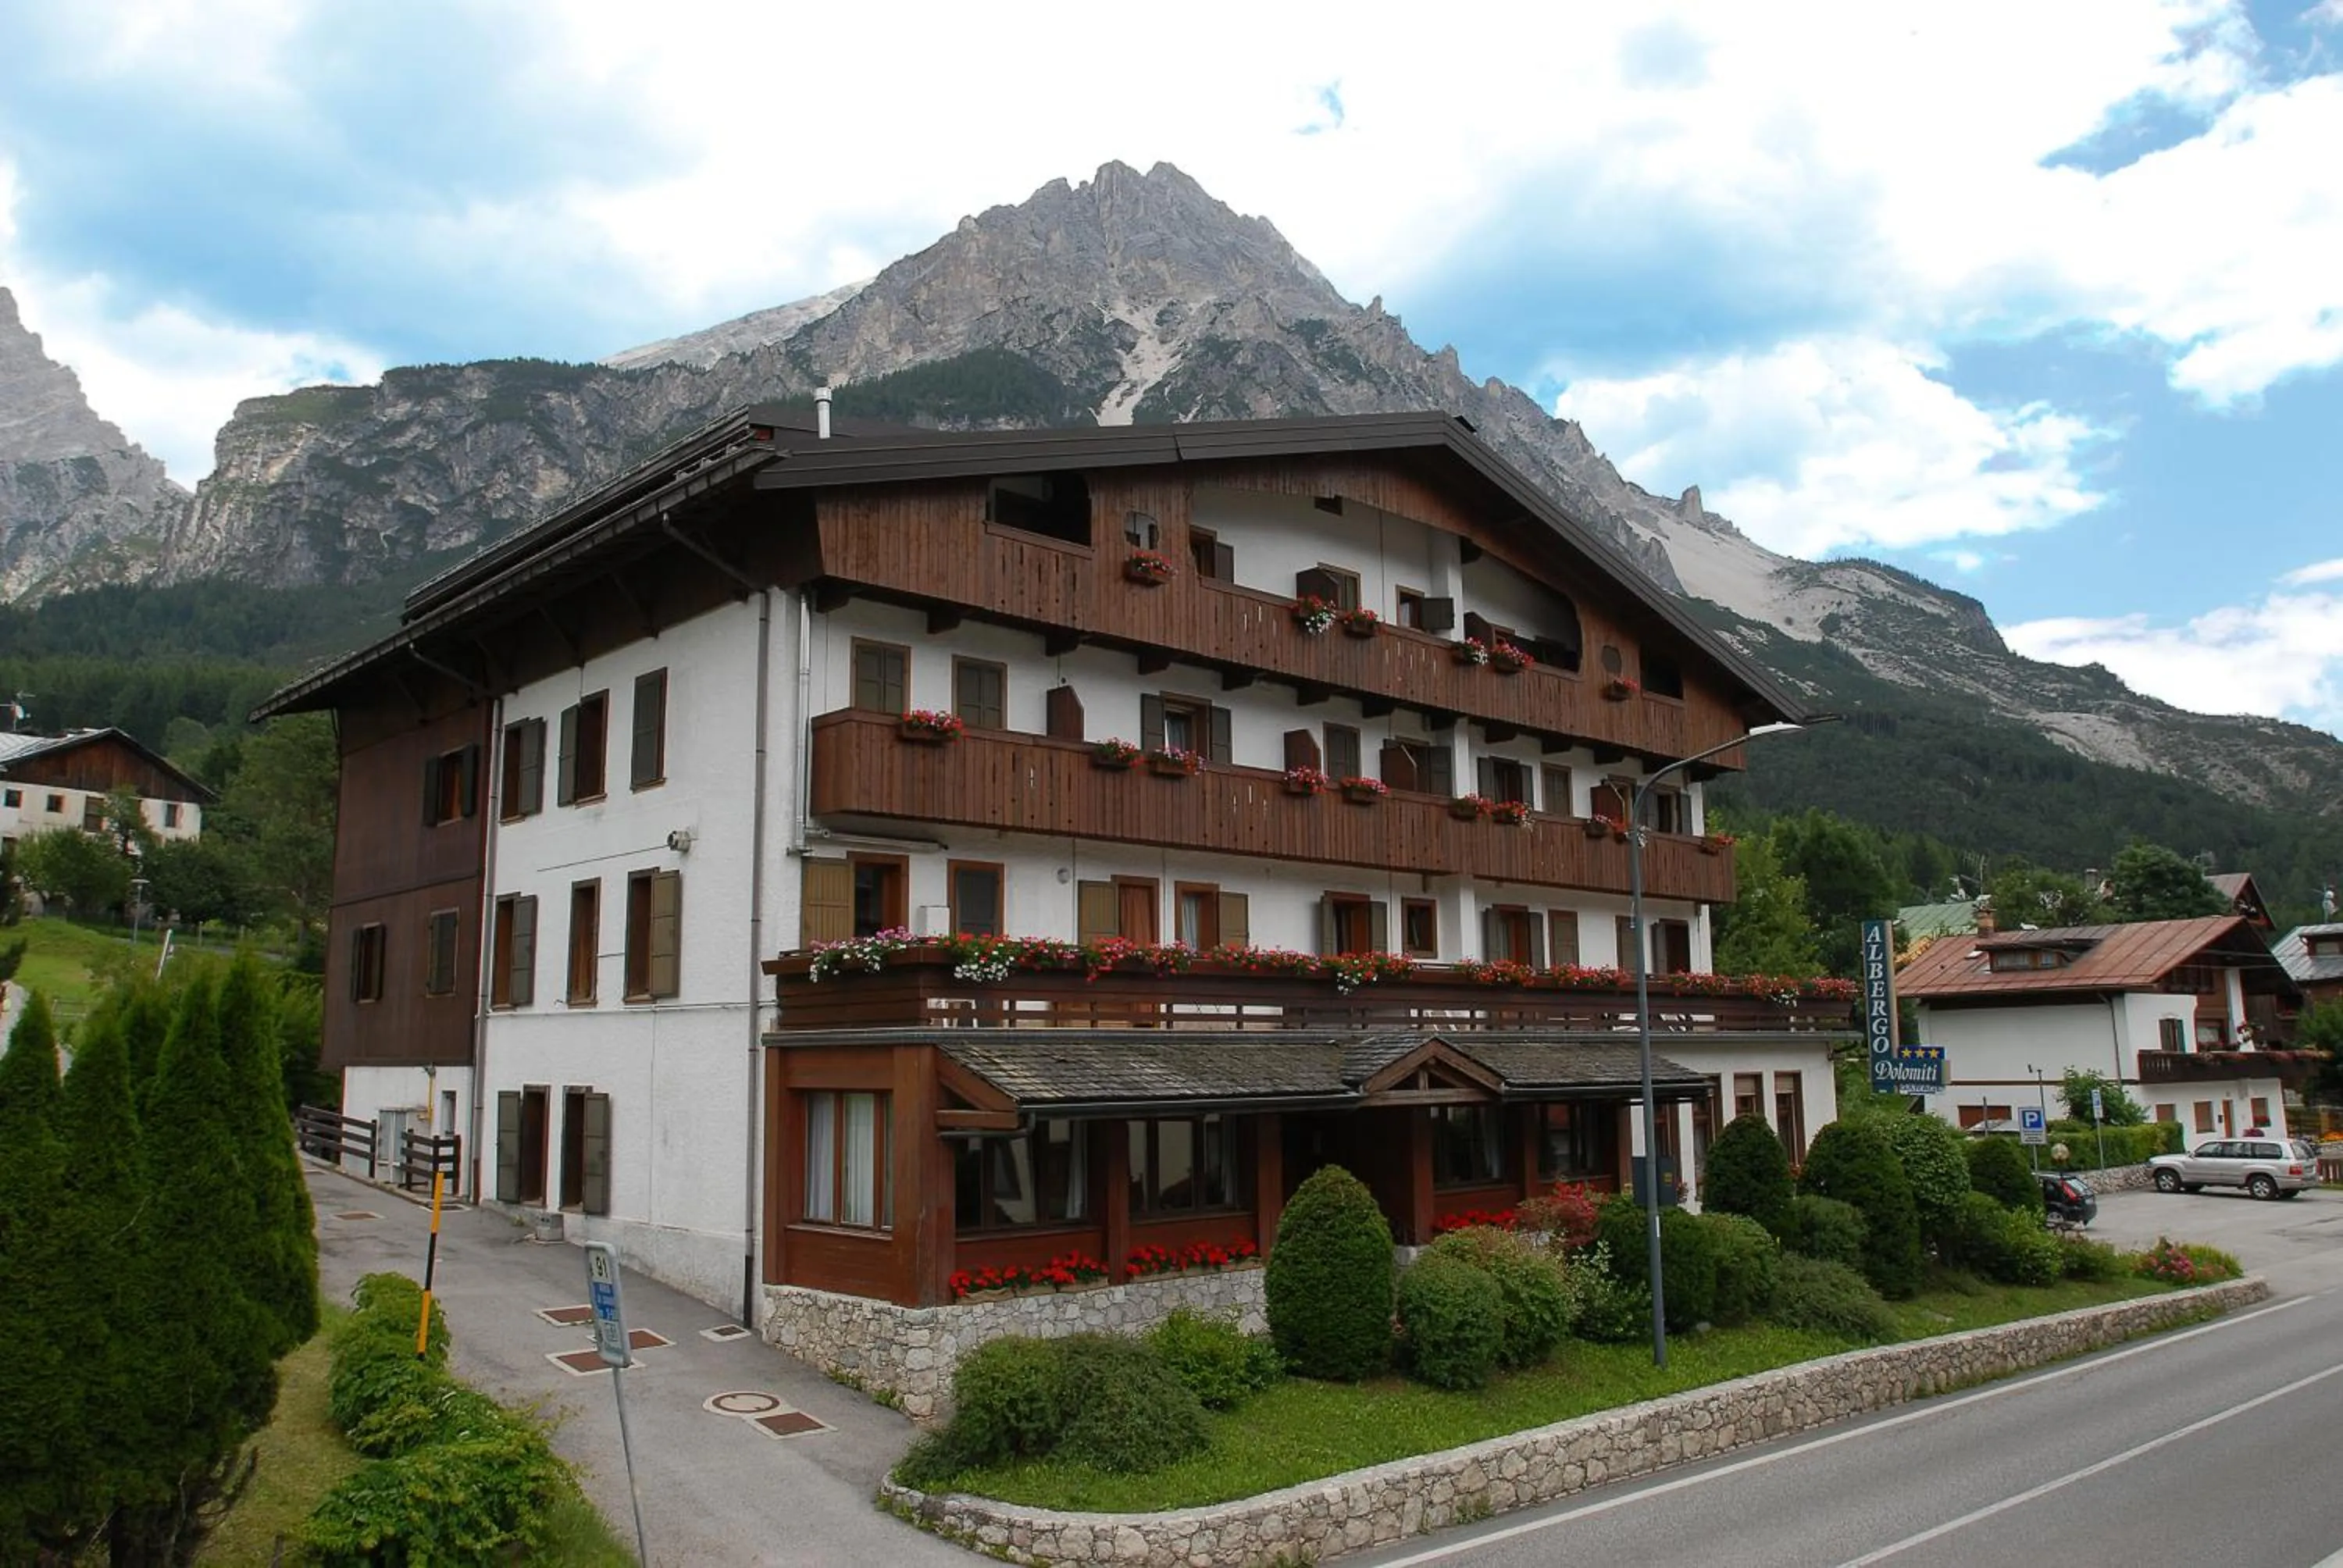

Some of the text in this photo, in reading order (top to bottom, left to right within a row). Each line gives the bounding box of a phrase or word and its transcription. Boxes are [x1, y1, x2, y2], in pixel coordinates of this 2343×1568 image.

[1866, 925, 1889, 1053] ALBERGO
[1874, 1060, 1938, 1081] Dolomiti
[2025, 1111, 2038, 1127] P
